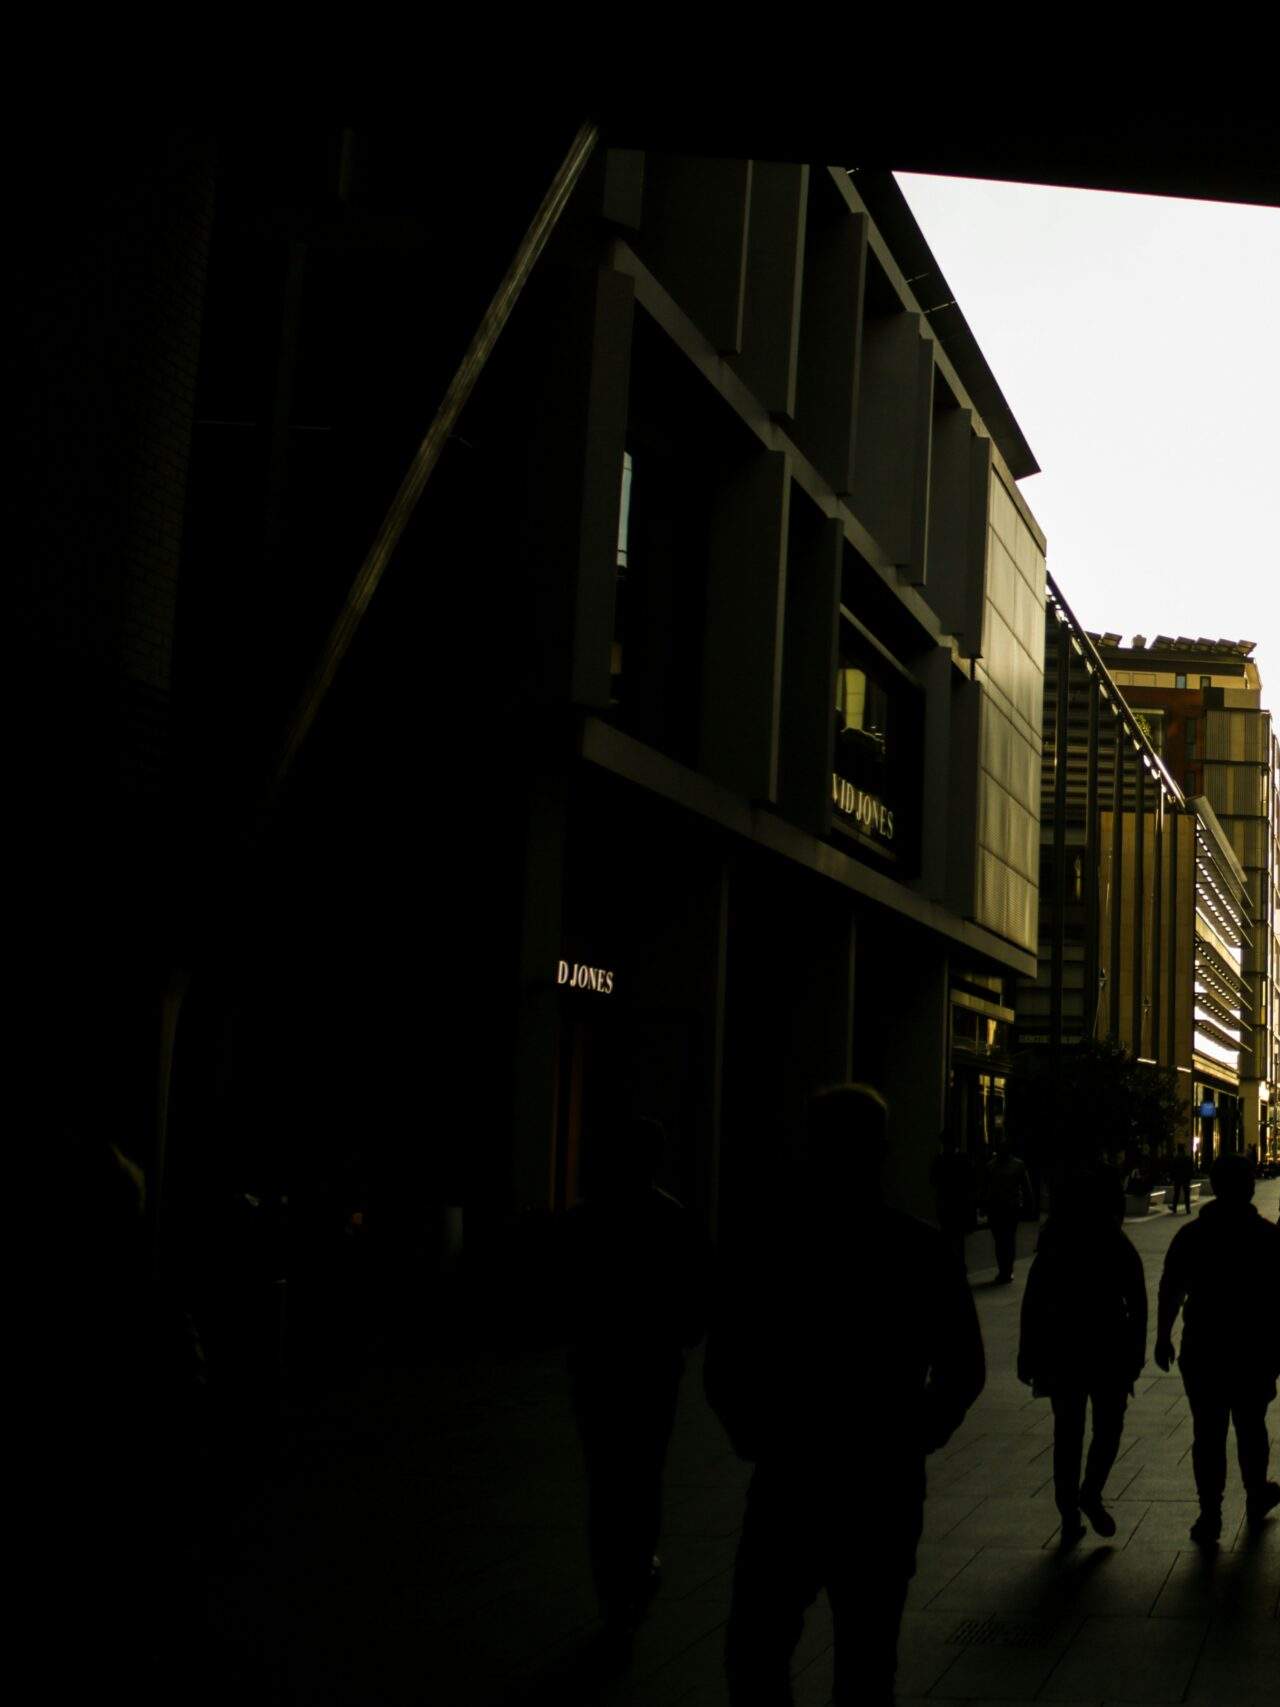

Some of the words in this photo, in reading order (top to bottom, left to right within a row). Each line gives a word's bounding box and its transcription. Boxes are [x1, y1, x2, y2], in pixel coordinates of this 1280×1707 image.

[856, 791, 894, 840] JONES
[557, 960, 569, 985] D
[570, 963, 615, 995] JONES
